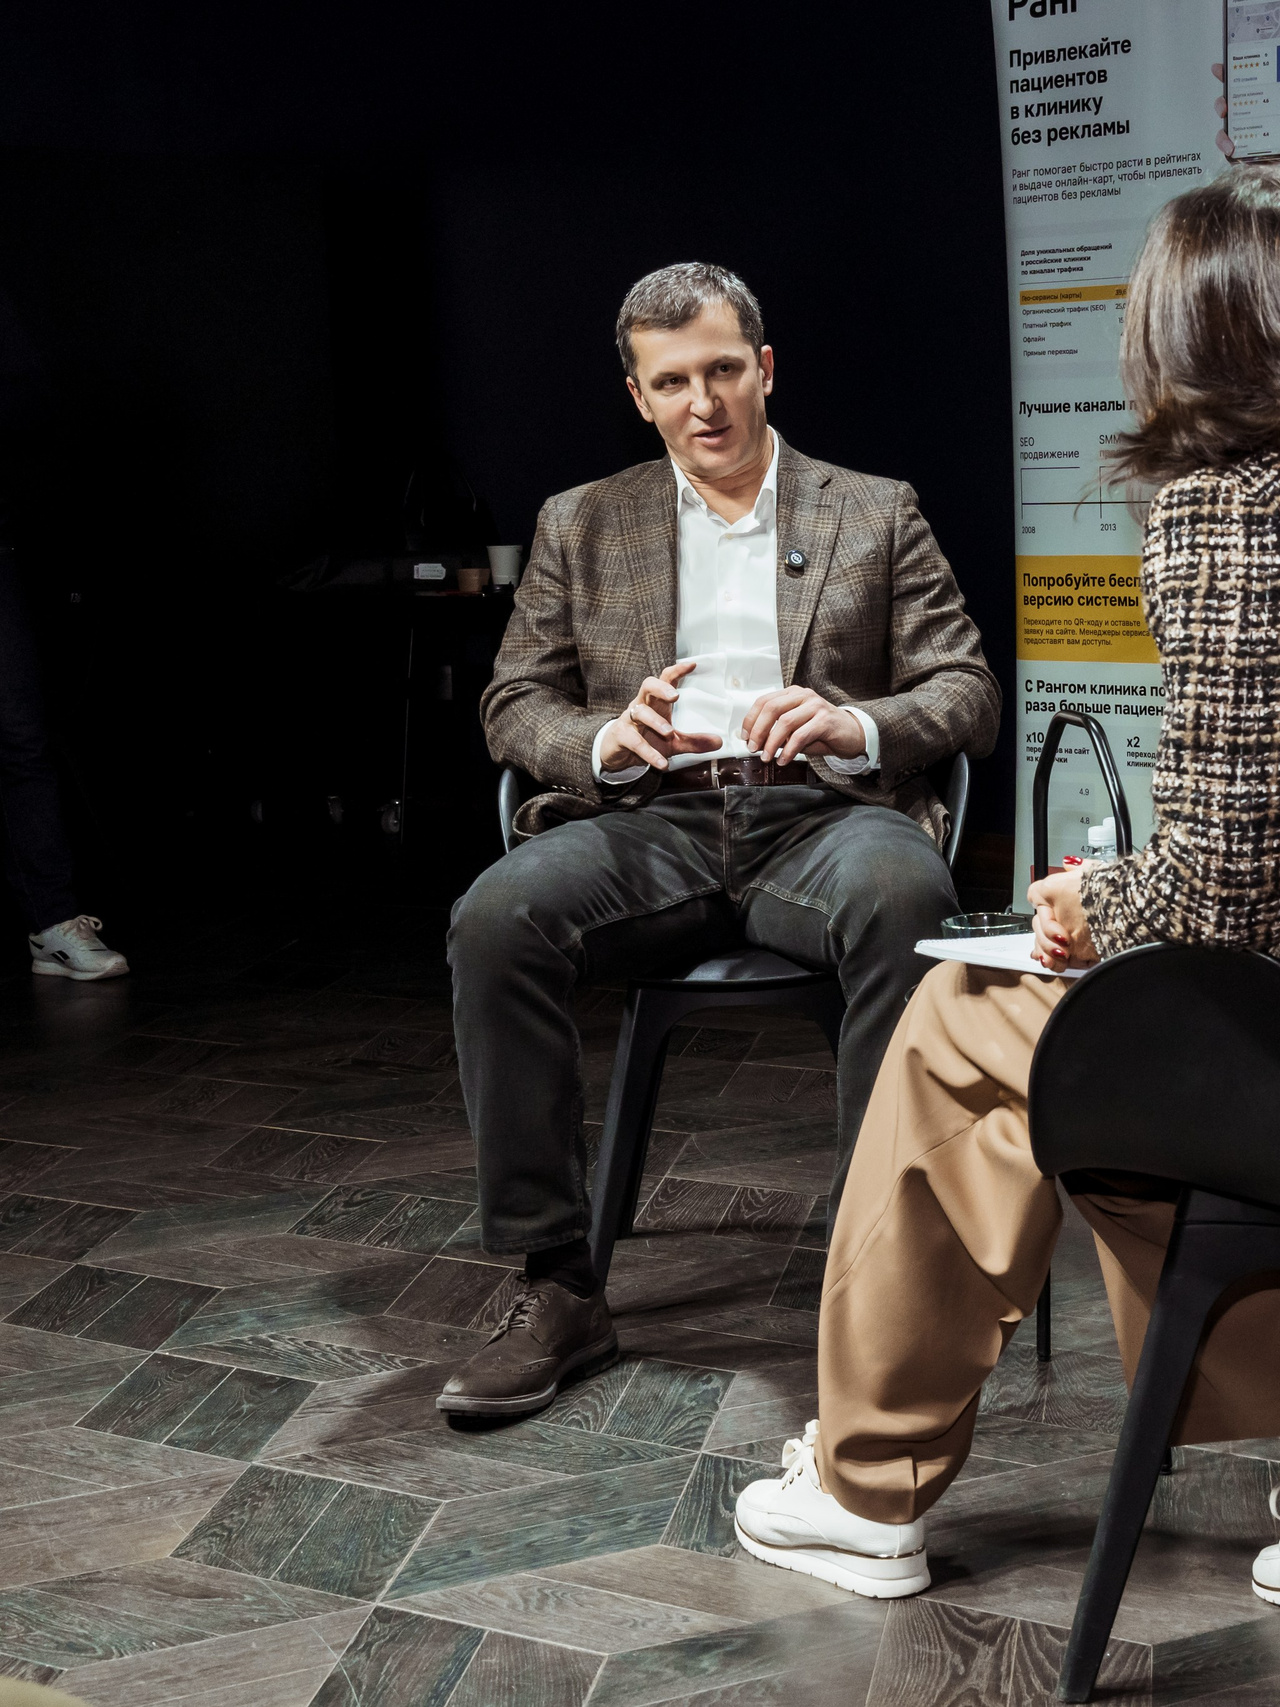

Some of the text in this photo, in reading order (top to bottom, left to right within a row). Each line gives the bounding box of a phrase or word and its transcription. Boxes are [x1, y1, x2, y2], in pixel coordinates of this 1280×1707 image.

[1009, 37, 1132, 70] Привлекайте
[1009, 69, 1108, 94] пациентов
[1010, 95, 1103, 119] в клинику
[1011, 119, 1130, 146] без рекламы
[1012, 152, 1201, 179] Ранг помогает быстро расти в рейтингах
[1019, 180, 1052, 191] выдаче
[1055, 174, 1115, 188] онлайн-карт,
[1118, 170, 1145, 181] чтобы
[1148, 166, 1202, 180] привлекать
[1013, 187, 1120, 205] пациентов без рекламы
[1020, 243, 1112, 257] Доля уникальных обращений
[1025, 257, 1062, 266] российские
[1056, 266, 1084, 274] трафика
[1060, 291, 1082, 300] (карты)
[1022, 307, 1065, 316] Органический
[1066, 305, 1089, 313] трафик
[1090, 304, 1106, 312] (SEO)
[1022, 321, 1047, 329] Платный
[1049, 320, 1072, 328] трафик
[1047, 348, 1078, 356] переходы
[1019, 401, 1070, 418] Лучшие
[1074, 400, 1125, 412] каналы
[1019, 437, 1035, 447] SEO
[1020, 450, 1079, 461] продвижение
[1022, 526, 1035, 534] 2008
[1023, 573, 1105, 590] Попробуйте
[1024, 595, 1139, 609] версию системы
[1024, 617, 1061, 626] Переходите
[1074, 618, 1103, 627] QR-коду
[1024, 628, 1044, 636] заявку
[1079, 628, 1120, 636] Менеджеры
[1025, 679, 1033, 692] С
[1037, 680, 1086, 694] Рангом
[1090, 684, 1146, 696] клиника
[1025, 700, 1056, 714] раза
[1059, 700, 1111, 714] больше
[1079, 788, 1090, 796] 4.9
